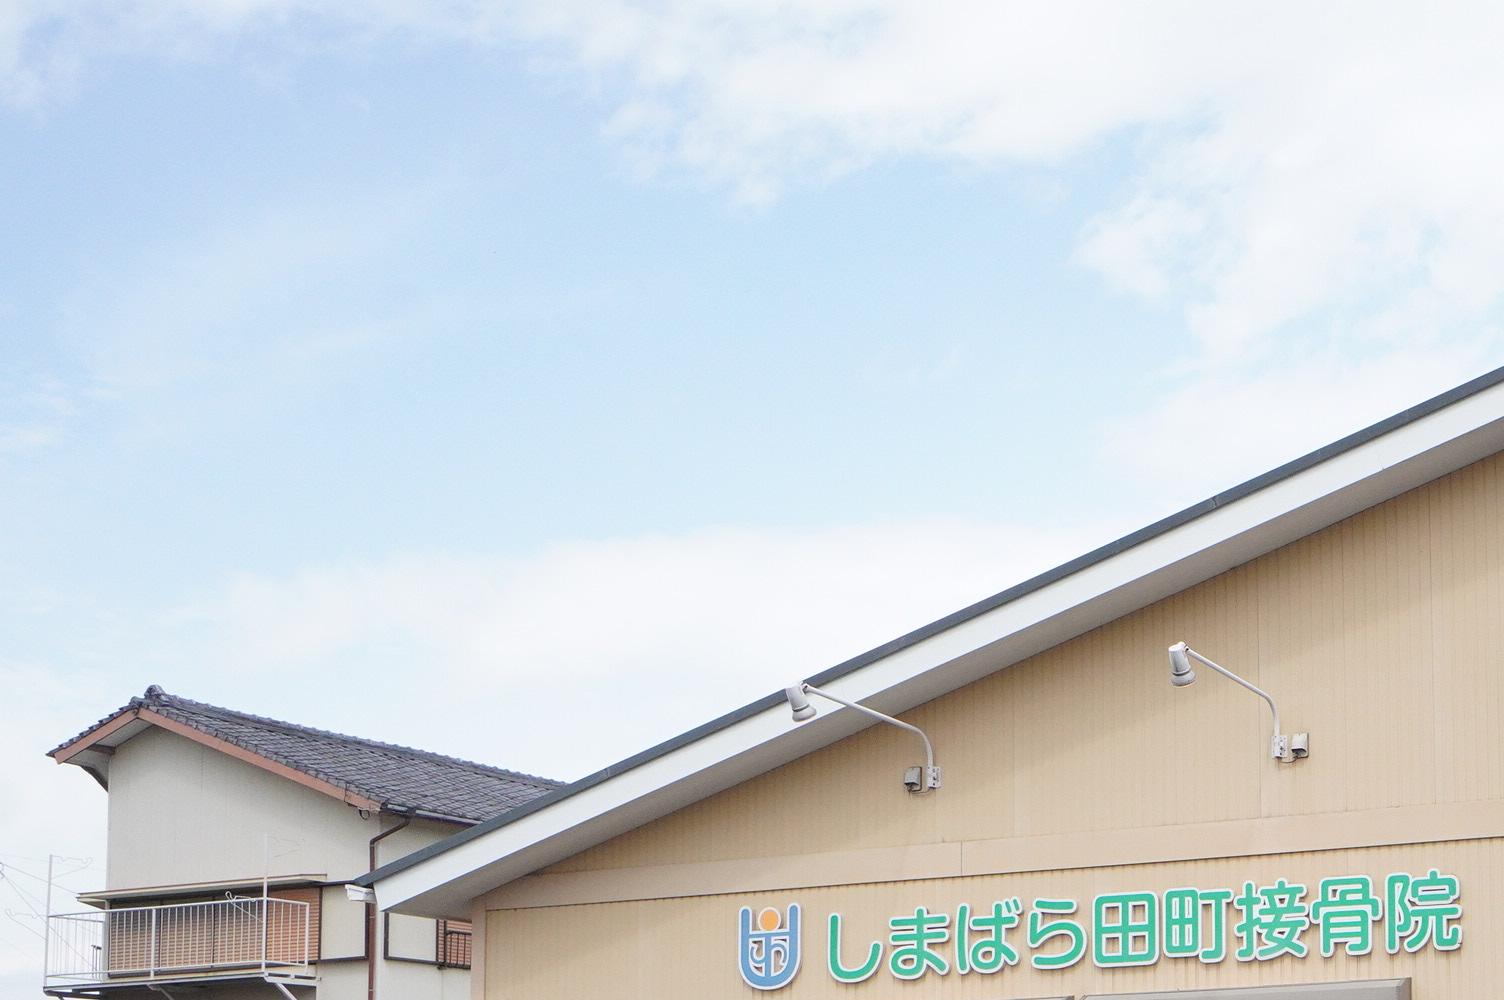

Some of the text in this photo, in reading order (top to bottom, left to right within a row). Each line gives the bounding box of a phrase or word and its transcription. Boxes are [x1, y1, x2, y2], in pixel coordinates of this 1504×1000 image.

[828, 870, 1463, 985] しまばら田町接骨院
